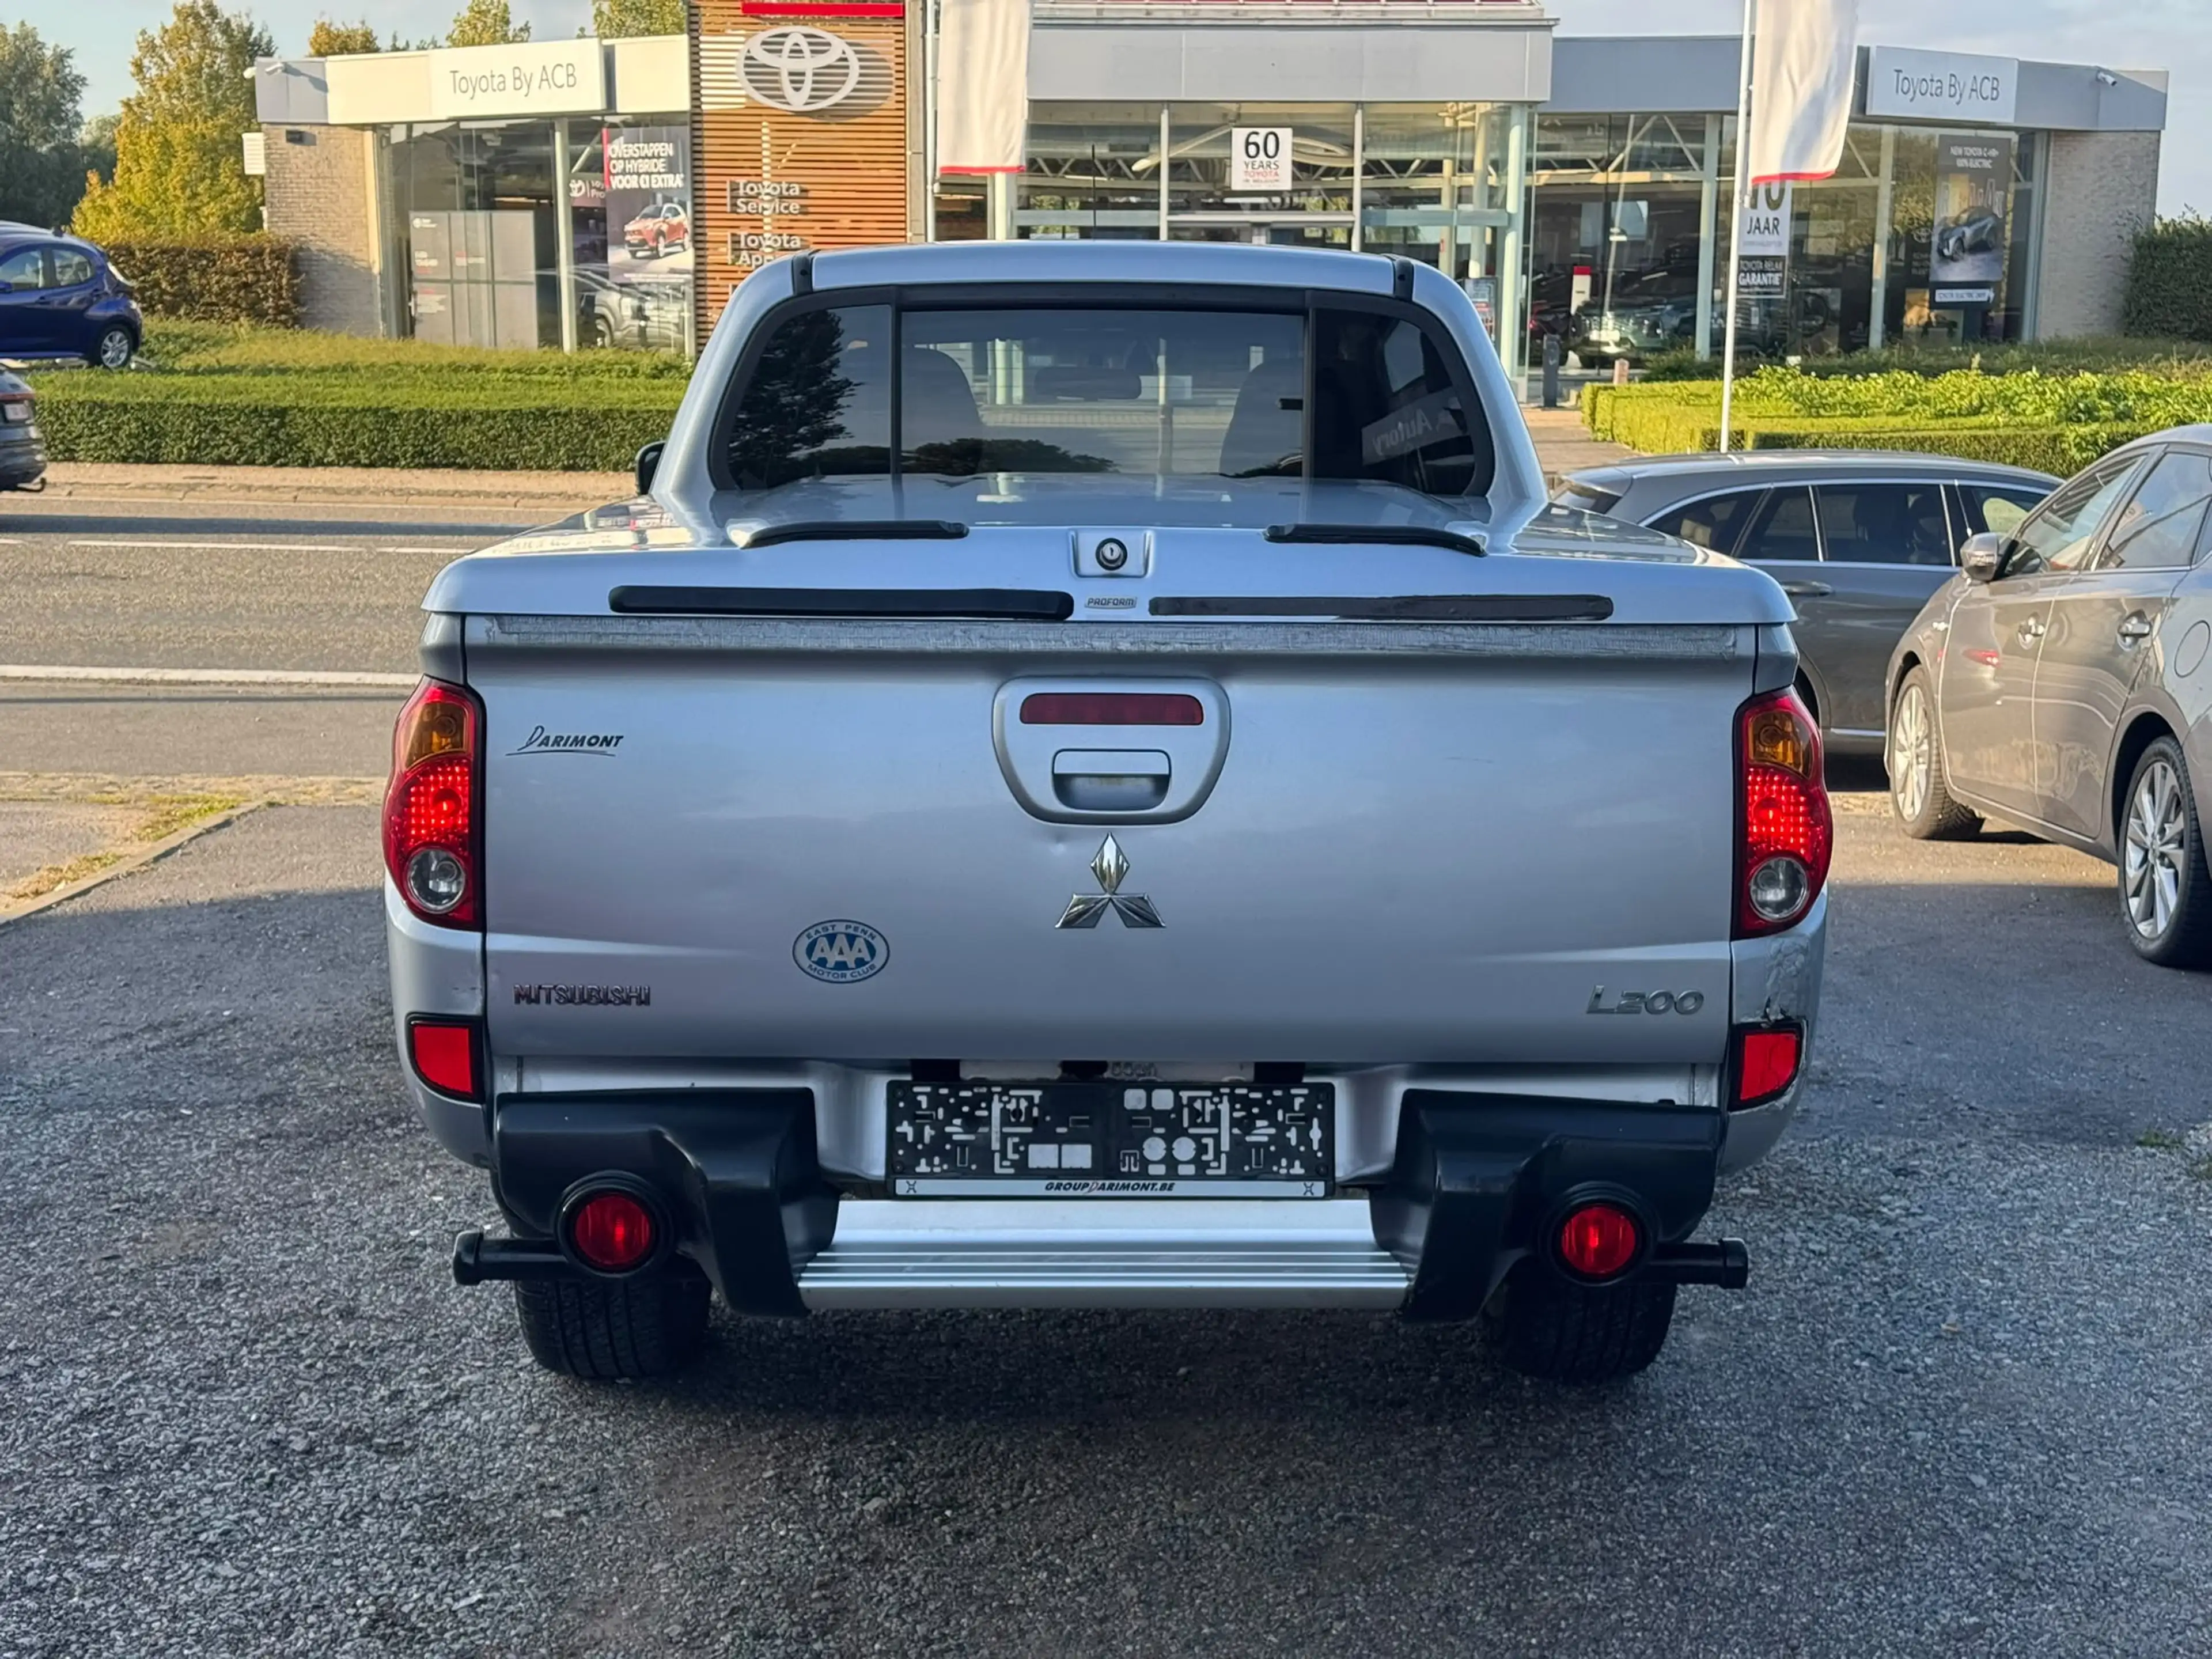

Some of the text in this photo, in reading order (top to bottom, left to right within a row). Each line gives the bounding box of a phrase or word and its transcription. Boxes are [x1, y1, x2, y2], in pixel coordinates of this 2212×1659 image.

[449, 63, 577, 100] Toyota By ACB
[1893, 69, 2000, 105] Toyota By ACB
[608, 143, 674, 158] OVERSTAPPEN
[1245, 131, 1280, 160] 60
[609, 158, 666, 173] OP HYBRIDE
[1244, 160, 1280, 171] YEARS
[609, 175, 639, 190] VOOR
[735, 179, 800, 199] Toyota
[736, 199, 801, 214] Service
[1747, 216, 1780, 236] JAAR
[738, 231, 801, 252] Toyota
[1087, 597, 1134, 606] PROFORM
[517, 725, 624, 751] DARIMONT
[805, 924, 876, 941] EAST PENN
[810, 933, 872, 969] AAA
[807, 963, 877, 979] MOTOR CLUB
[514, 984, 651, 1006] MITSUBISHI
[1586, 984, 1705, 1016] L200
[1044, 1181, 1176, 1195] GROUPDARIMONT.BE
